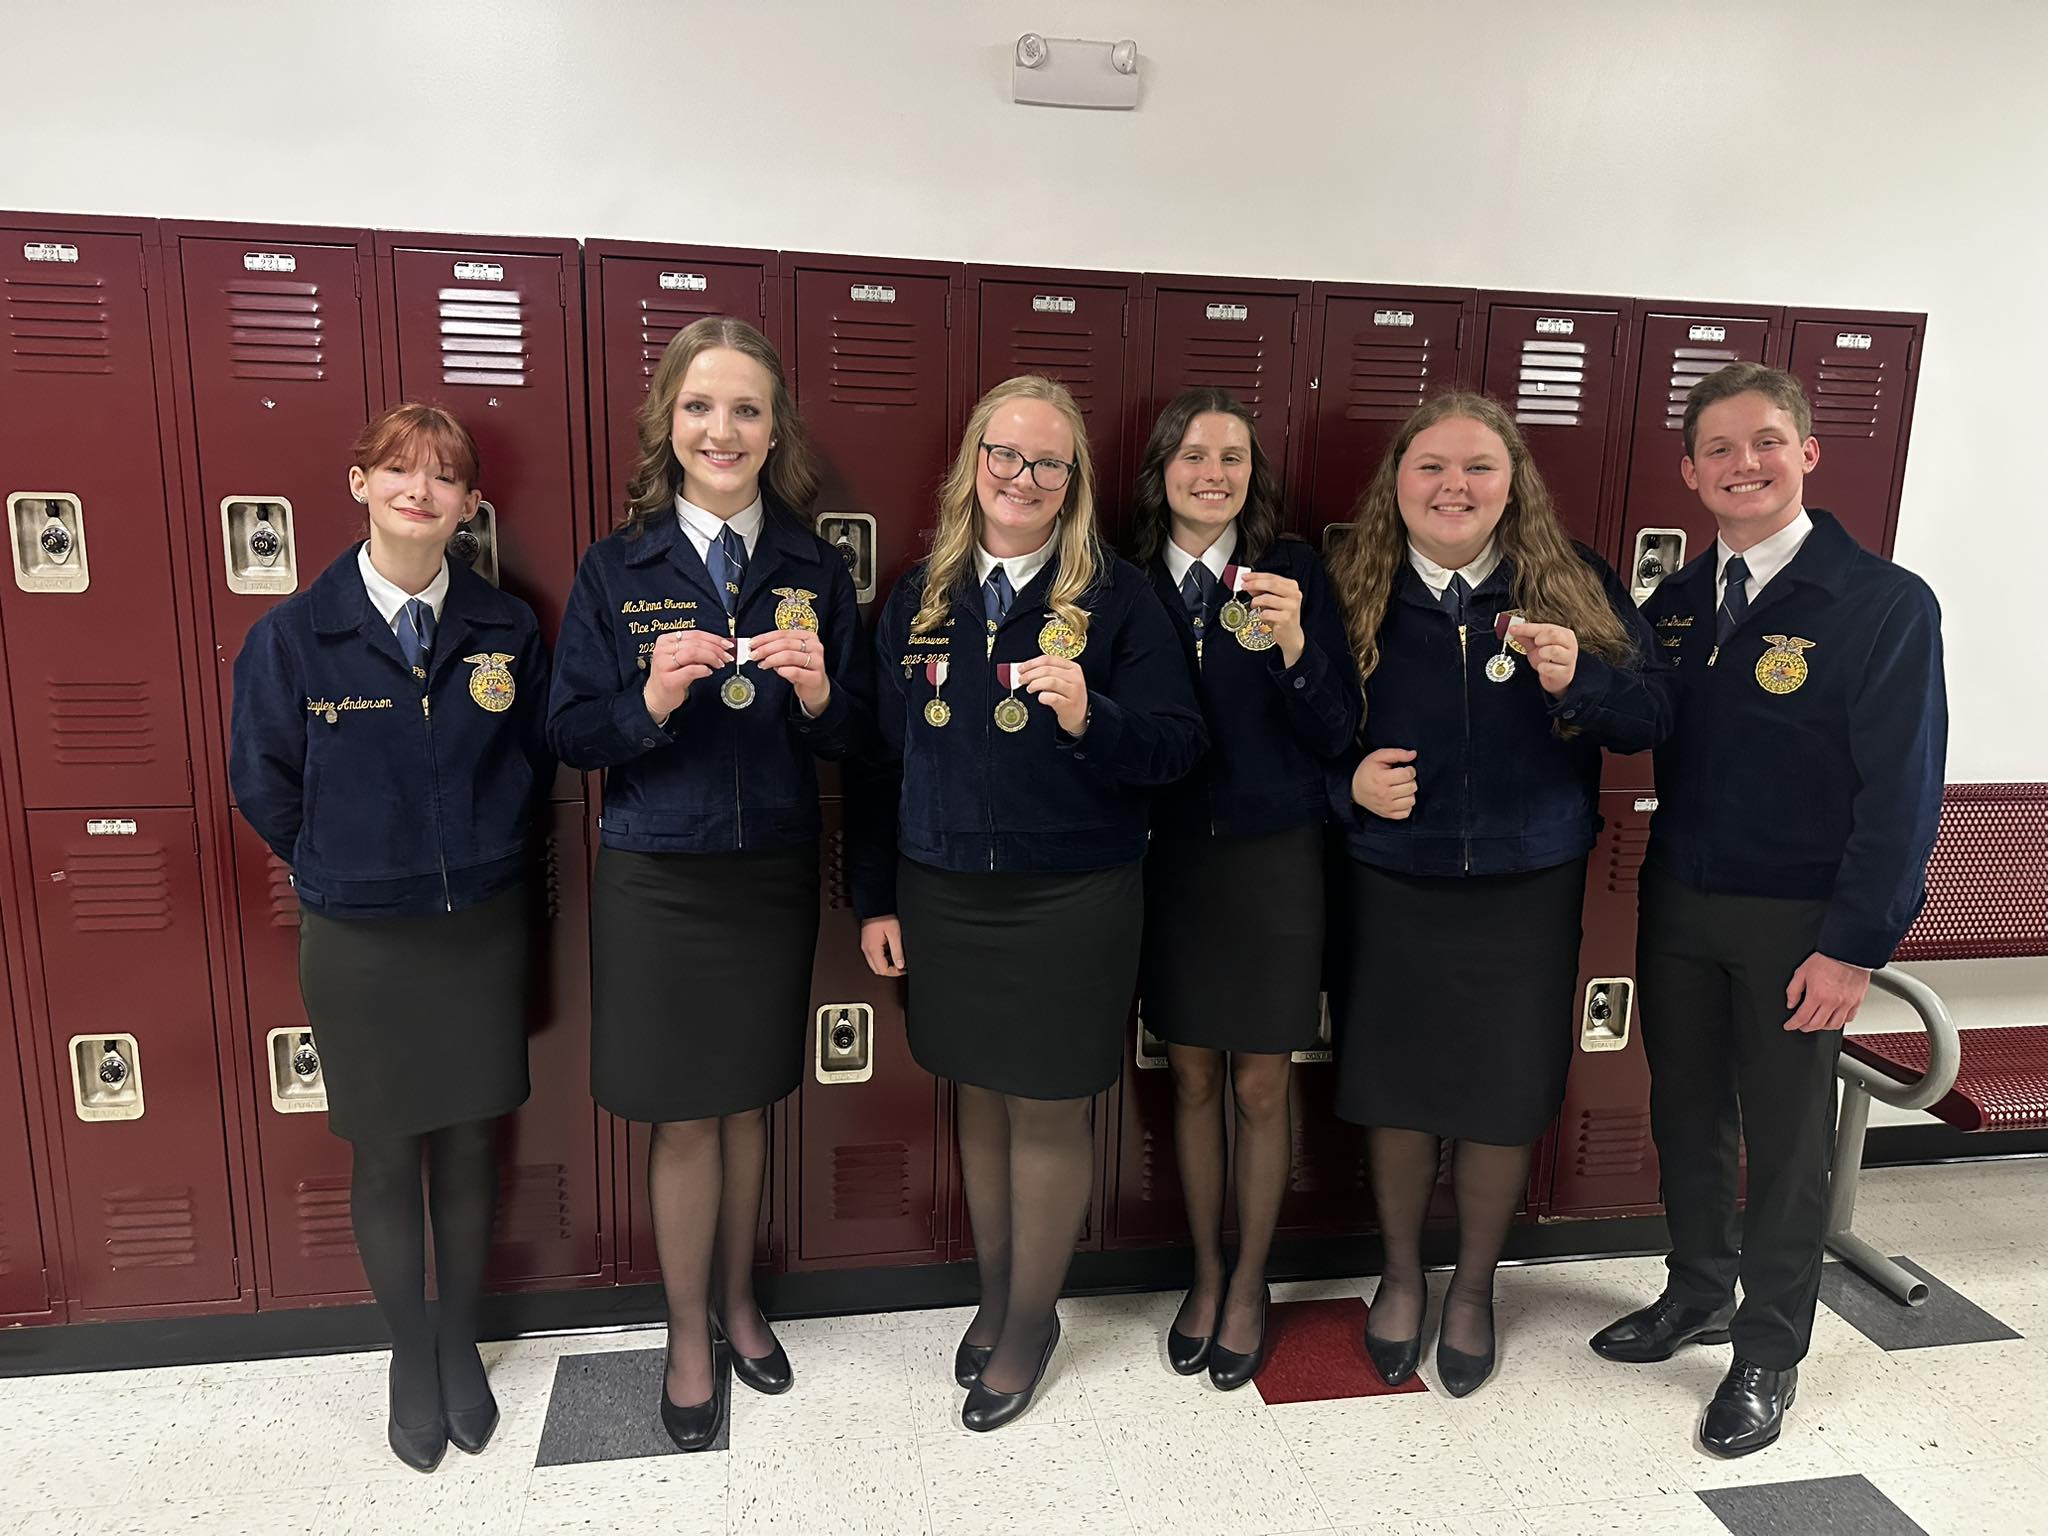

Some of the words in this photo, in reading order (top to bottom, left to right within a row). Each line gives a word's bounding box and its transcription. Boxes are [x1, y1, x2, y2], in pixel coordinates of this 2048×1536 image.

[41, 249, 61, 260] 221
[865, 290, 881, 300] 229
[1046, 301, 1061, 311] 231
[621, 599, 662, 613] McKinna
[664, 598, 698, 609] Turner
[628, 621, 649, 634] Vice
[650, 617, 696, 632] President
[908, 633, 949, 645] Treasurer
[901, 653, 950, 664] 2025-2026
[337, 695, 393, 709] Anderson
[103, 824, 121, 833] 222
